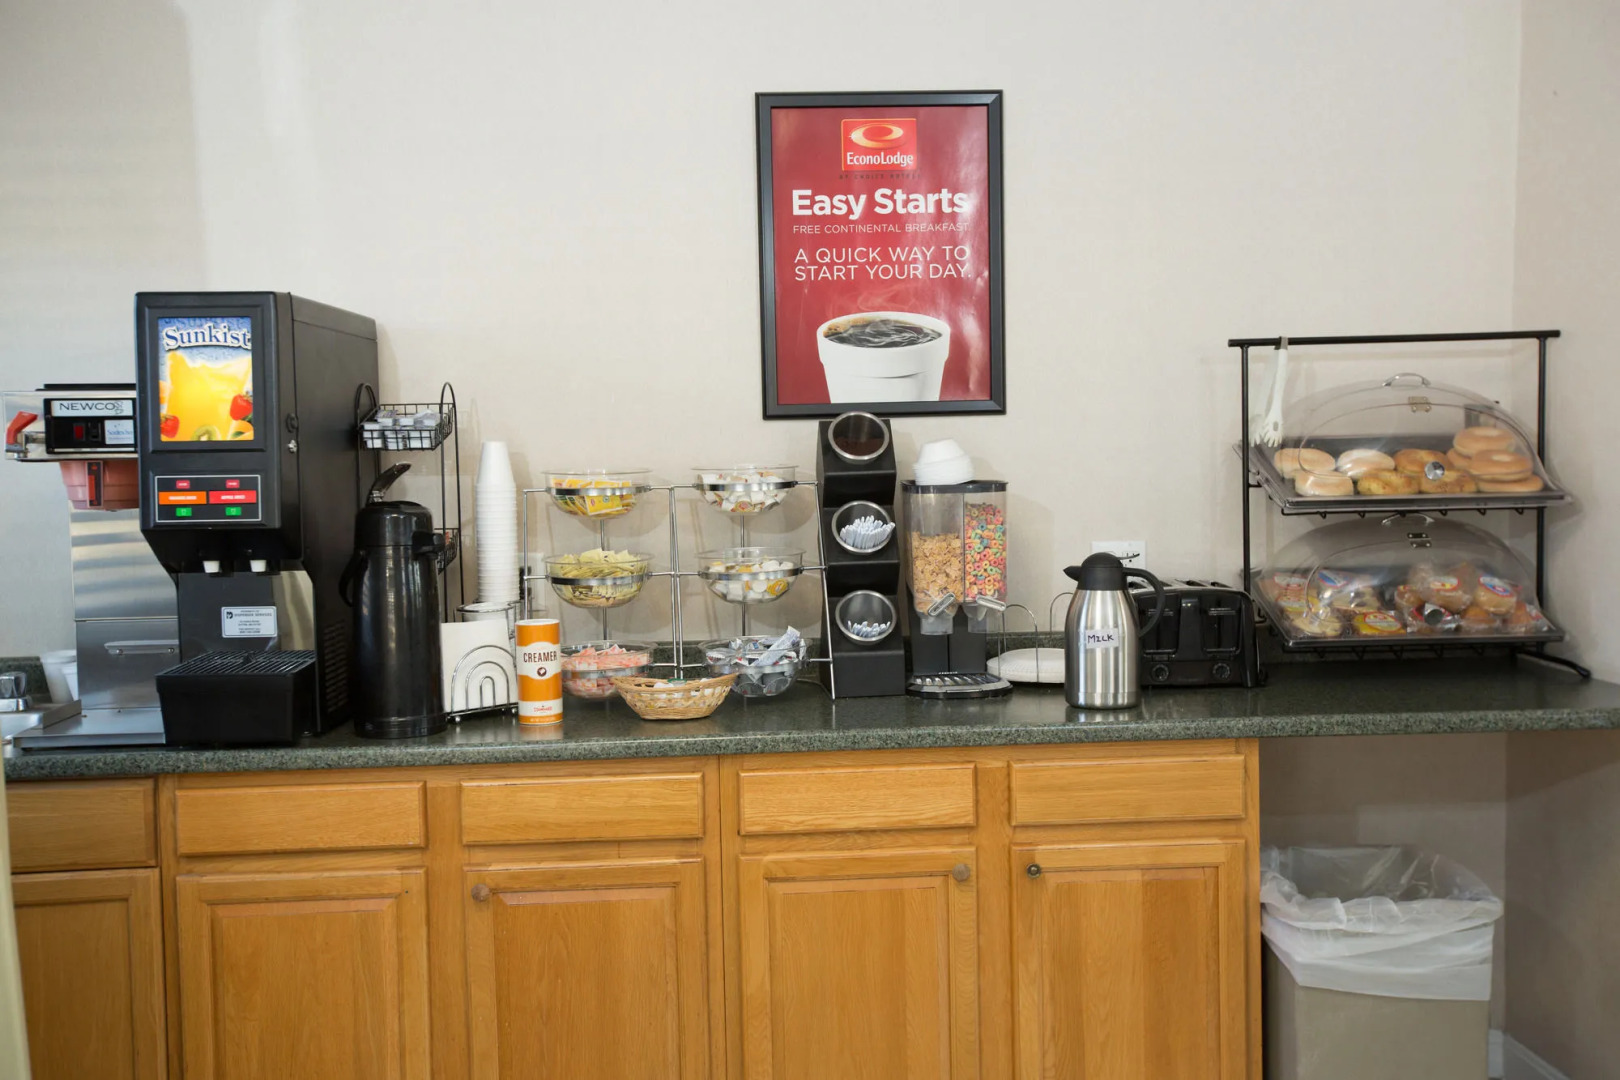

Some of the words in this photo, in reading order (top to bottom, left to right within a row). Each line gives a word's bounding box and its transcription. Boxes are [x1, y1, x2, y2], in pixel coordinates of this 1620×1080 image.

[846, 152, 914, 167] EconoLodge
[792, 189, 867, 220] Easy
[873, 187, 971, 215] Starts
[793, 225, 821, 234] FREE
[824, 224, 901, 234] CONTINENTAL
[905, 223, 969, 233] BREAKFAST
[794, 248, 809, 264] A
[815, 247, 882, 263] QUICK
[888, 246, 936, 262] WAY
[941, 245, 970, 261] TO
[794, 265, 858, 281] START
[865, 264, 922, 280] YOUR
[929, 263, 972, 279] DAY.
[163, 324, 251, 350] Sunkist
[59, 402, 116, 411] NEWCO
[523, 651, 557, 663] CREAMER
